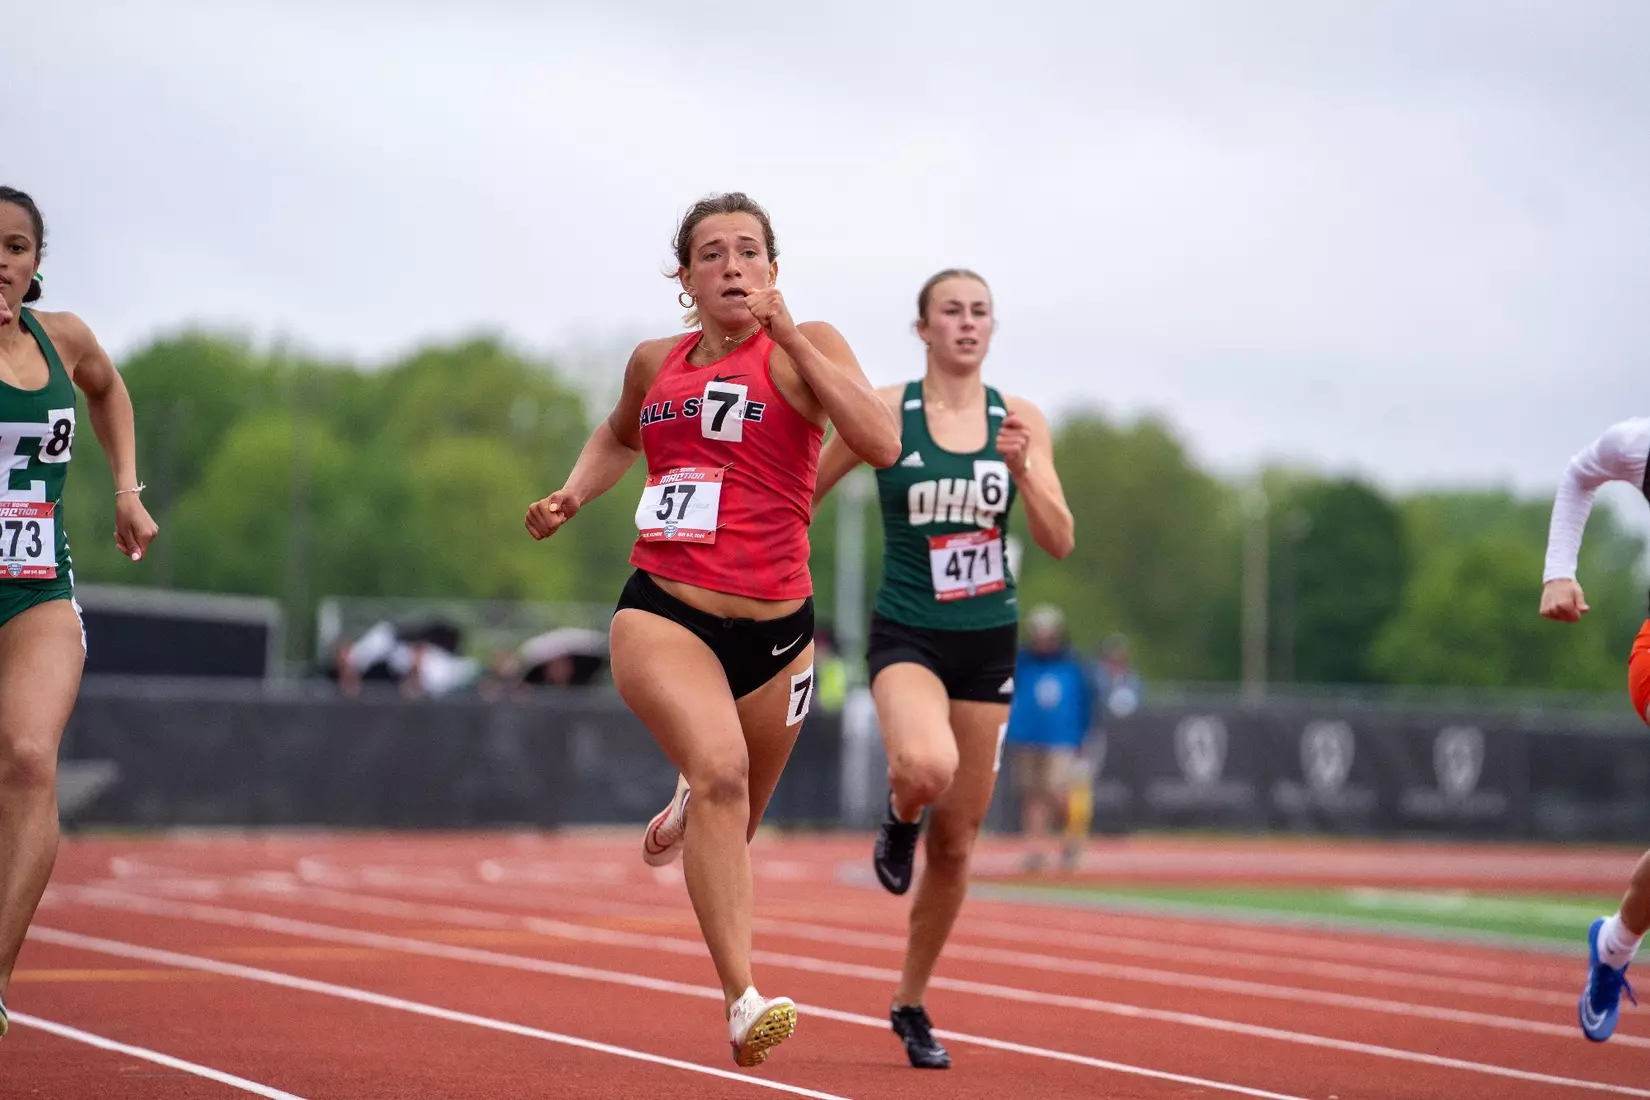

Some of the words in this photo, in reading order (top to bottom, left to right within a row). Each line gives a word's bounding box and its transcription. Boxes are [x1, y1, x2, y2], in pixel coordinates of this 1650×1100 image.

[639, 400, 677, 429] ALL
[707, 390, 740, 433] 7
[45, 418, 72, 457] 8
[656, 484, 697, 521] 57
[907, 477, 995, 529] OHI
[981, 472, 1002, 506] 6
[0, 520, 43, 558] 73
[944, 543, 991, 581] 471
[794, 674, 812, 717] 7
